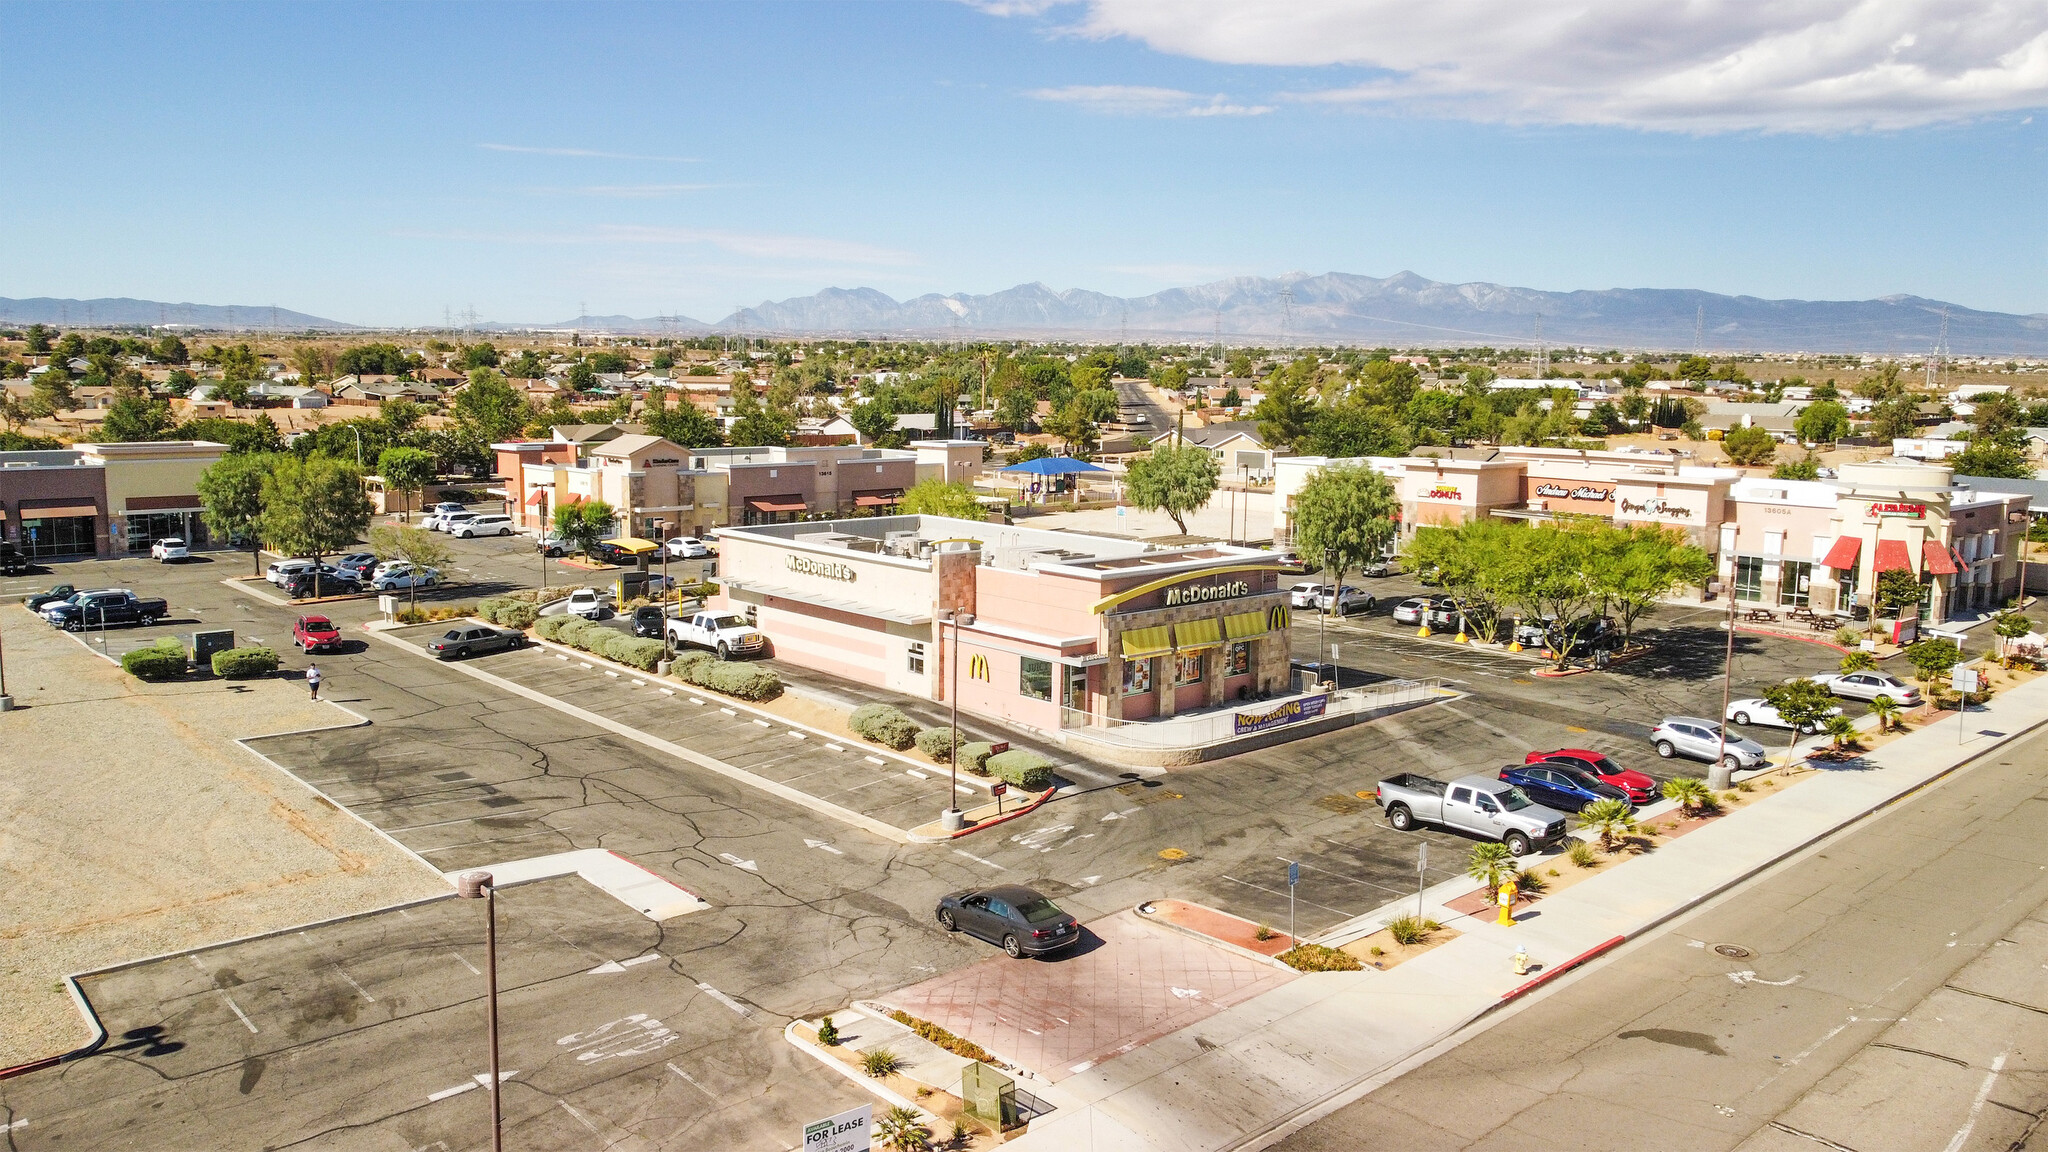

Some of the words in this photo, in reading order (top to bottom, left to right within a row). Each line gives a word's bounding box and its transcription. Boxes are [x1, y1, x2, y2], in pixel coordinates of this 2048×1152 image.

[1430, 490, 1461, 500] DONUTS
[1536, 484, 1569, 498] Andrew
[1571, 487, 1608, 501] Michael
[785, 554, 852, 580] McDonald's
[1166, 581, 1248, 606] McDonald's
[1237, 714, 1263, 726] NOW
[807, 1130, 828, 1145] FOR
[833, 1117, 863, 1135] LEASE
